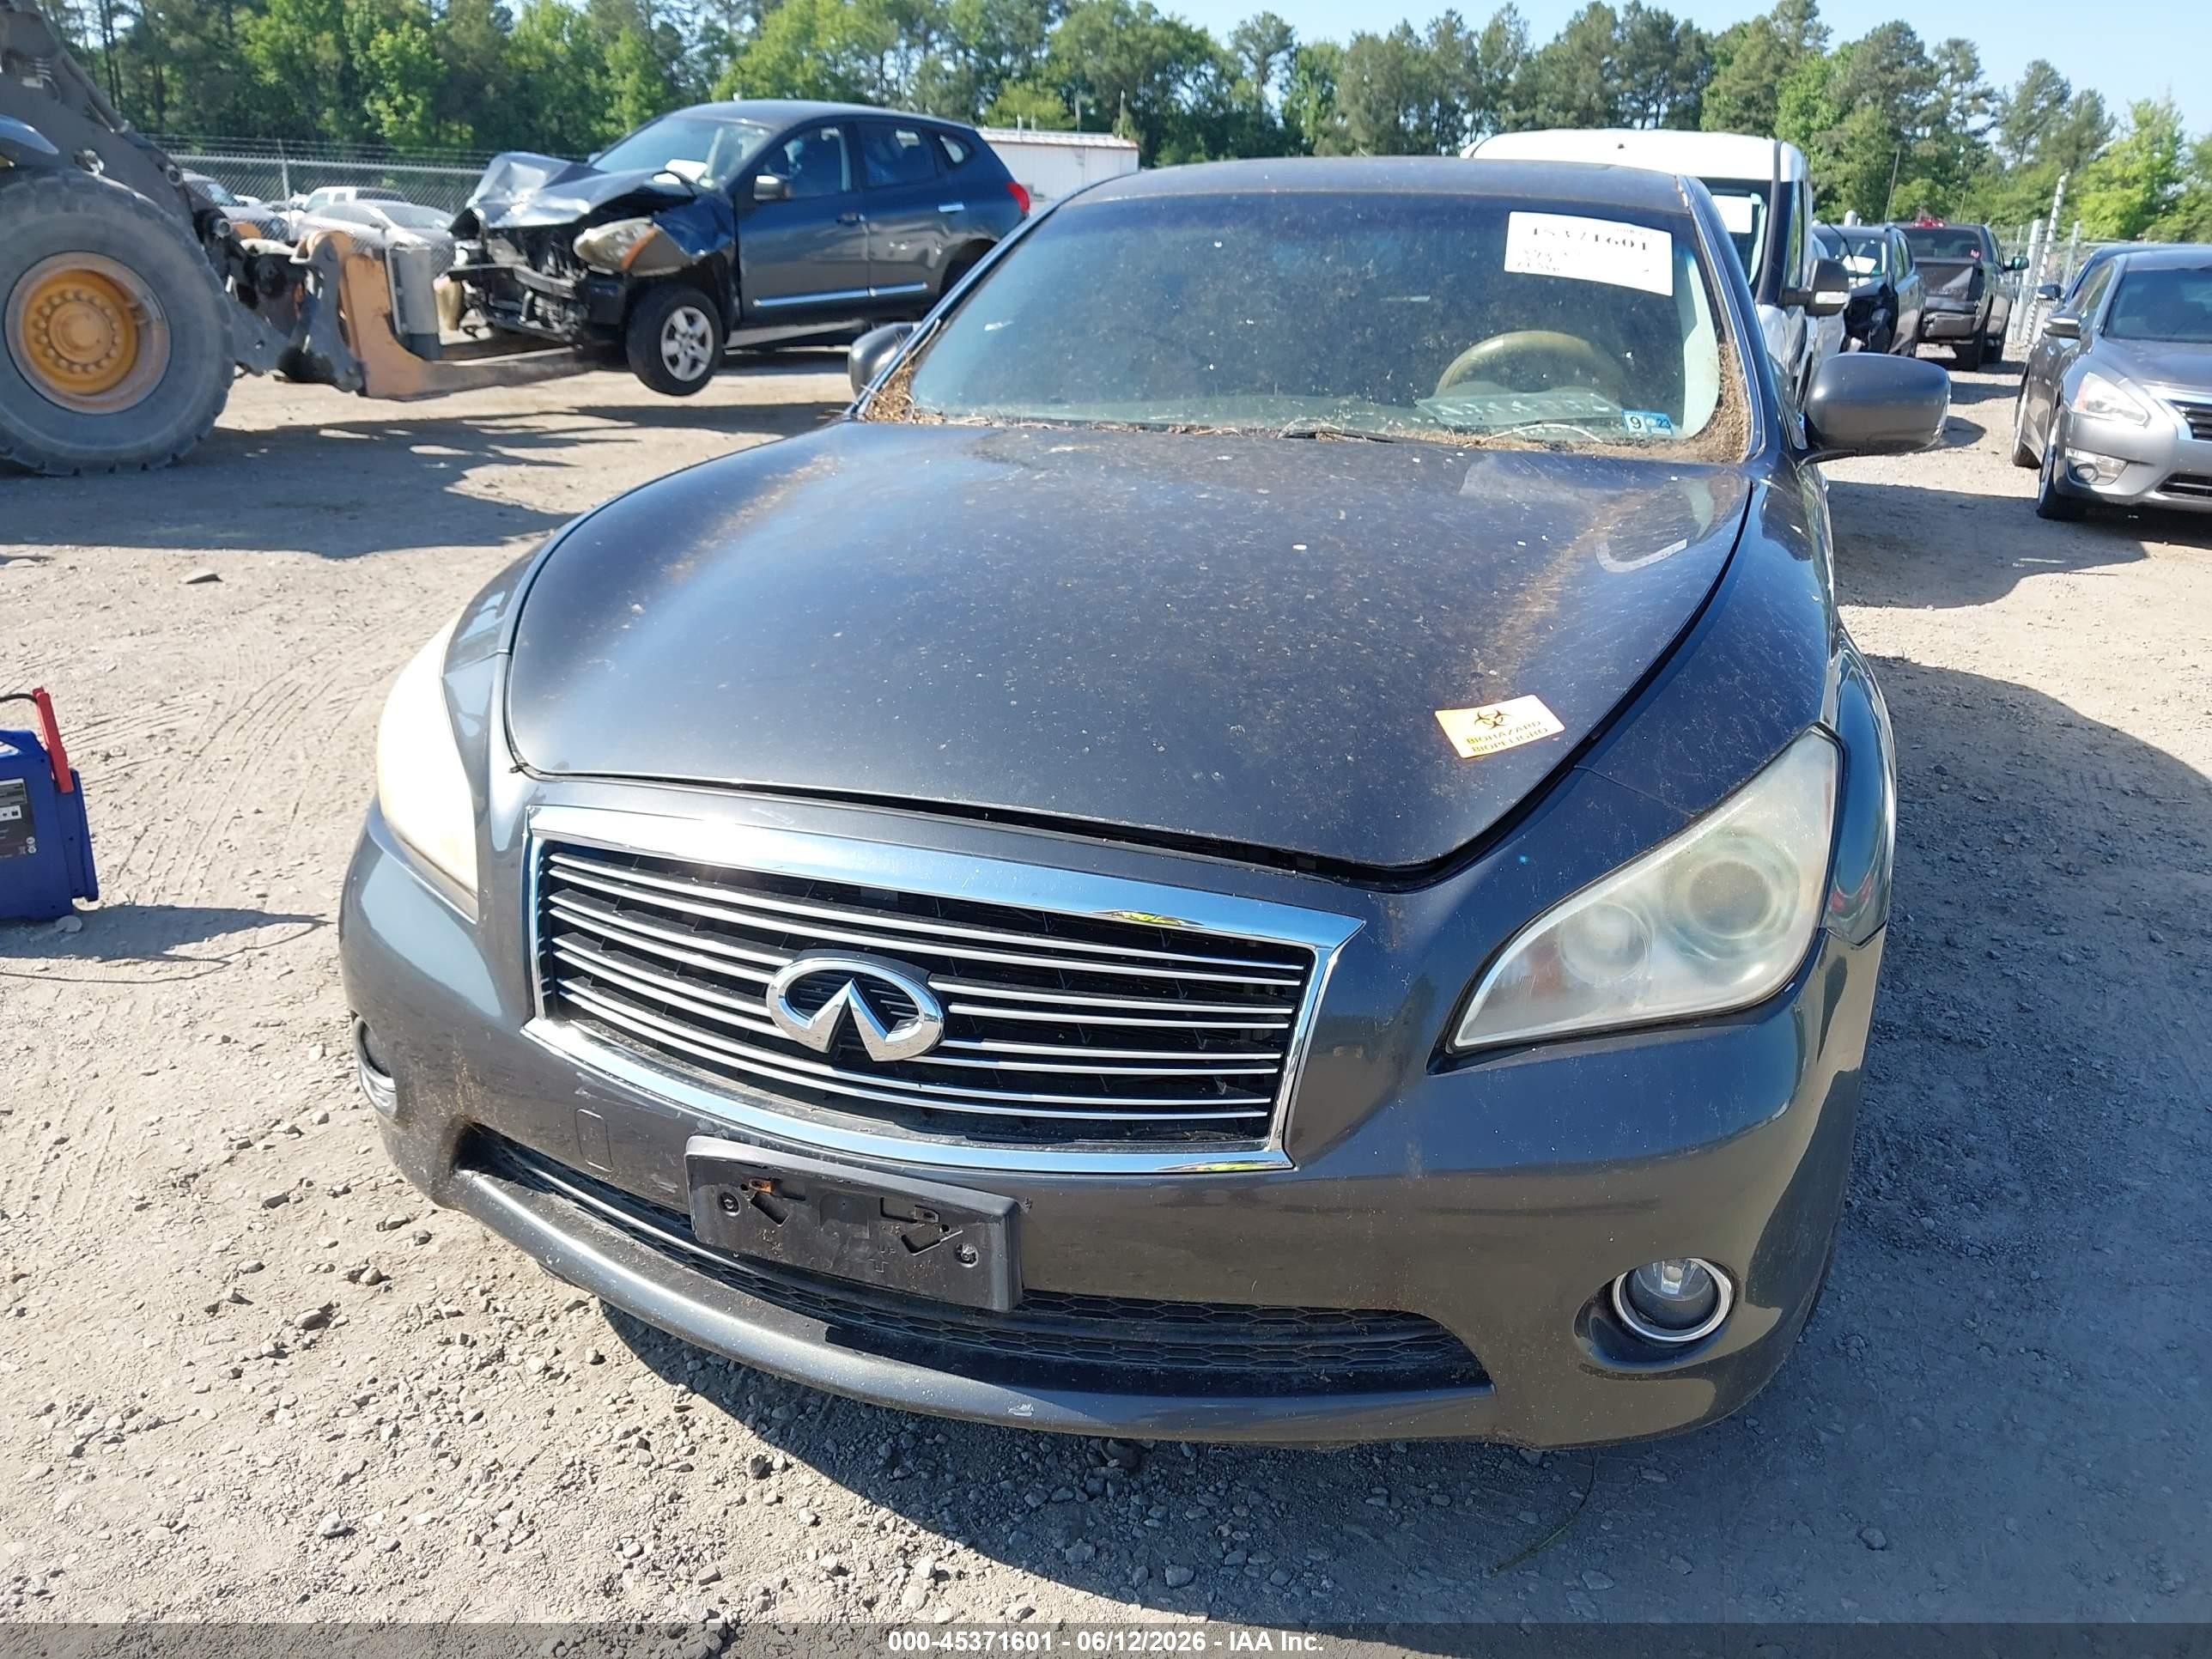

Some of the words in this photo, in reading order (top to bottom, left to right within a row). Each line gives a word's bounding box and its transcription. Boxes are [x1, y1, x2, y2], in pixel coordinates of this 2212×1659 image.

[1629, 416, 1642, 429] 9
[1656, 418, 1672, 429] 23
[1466, 720, 1541, 744] BIOHAZARD
